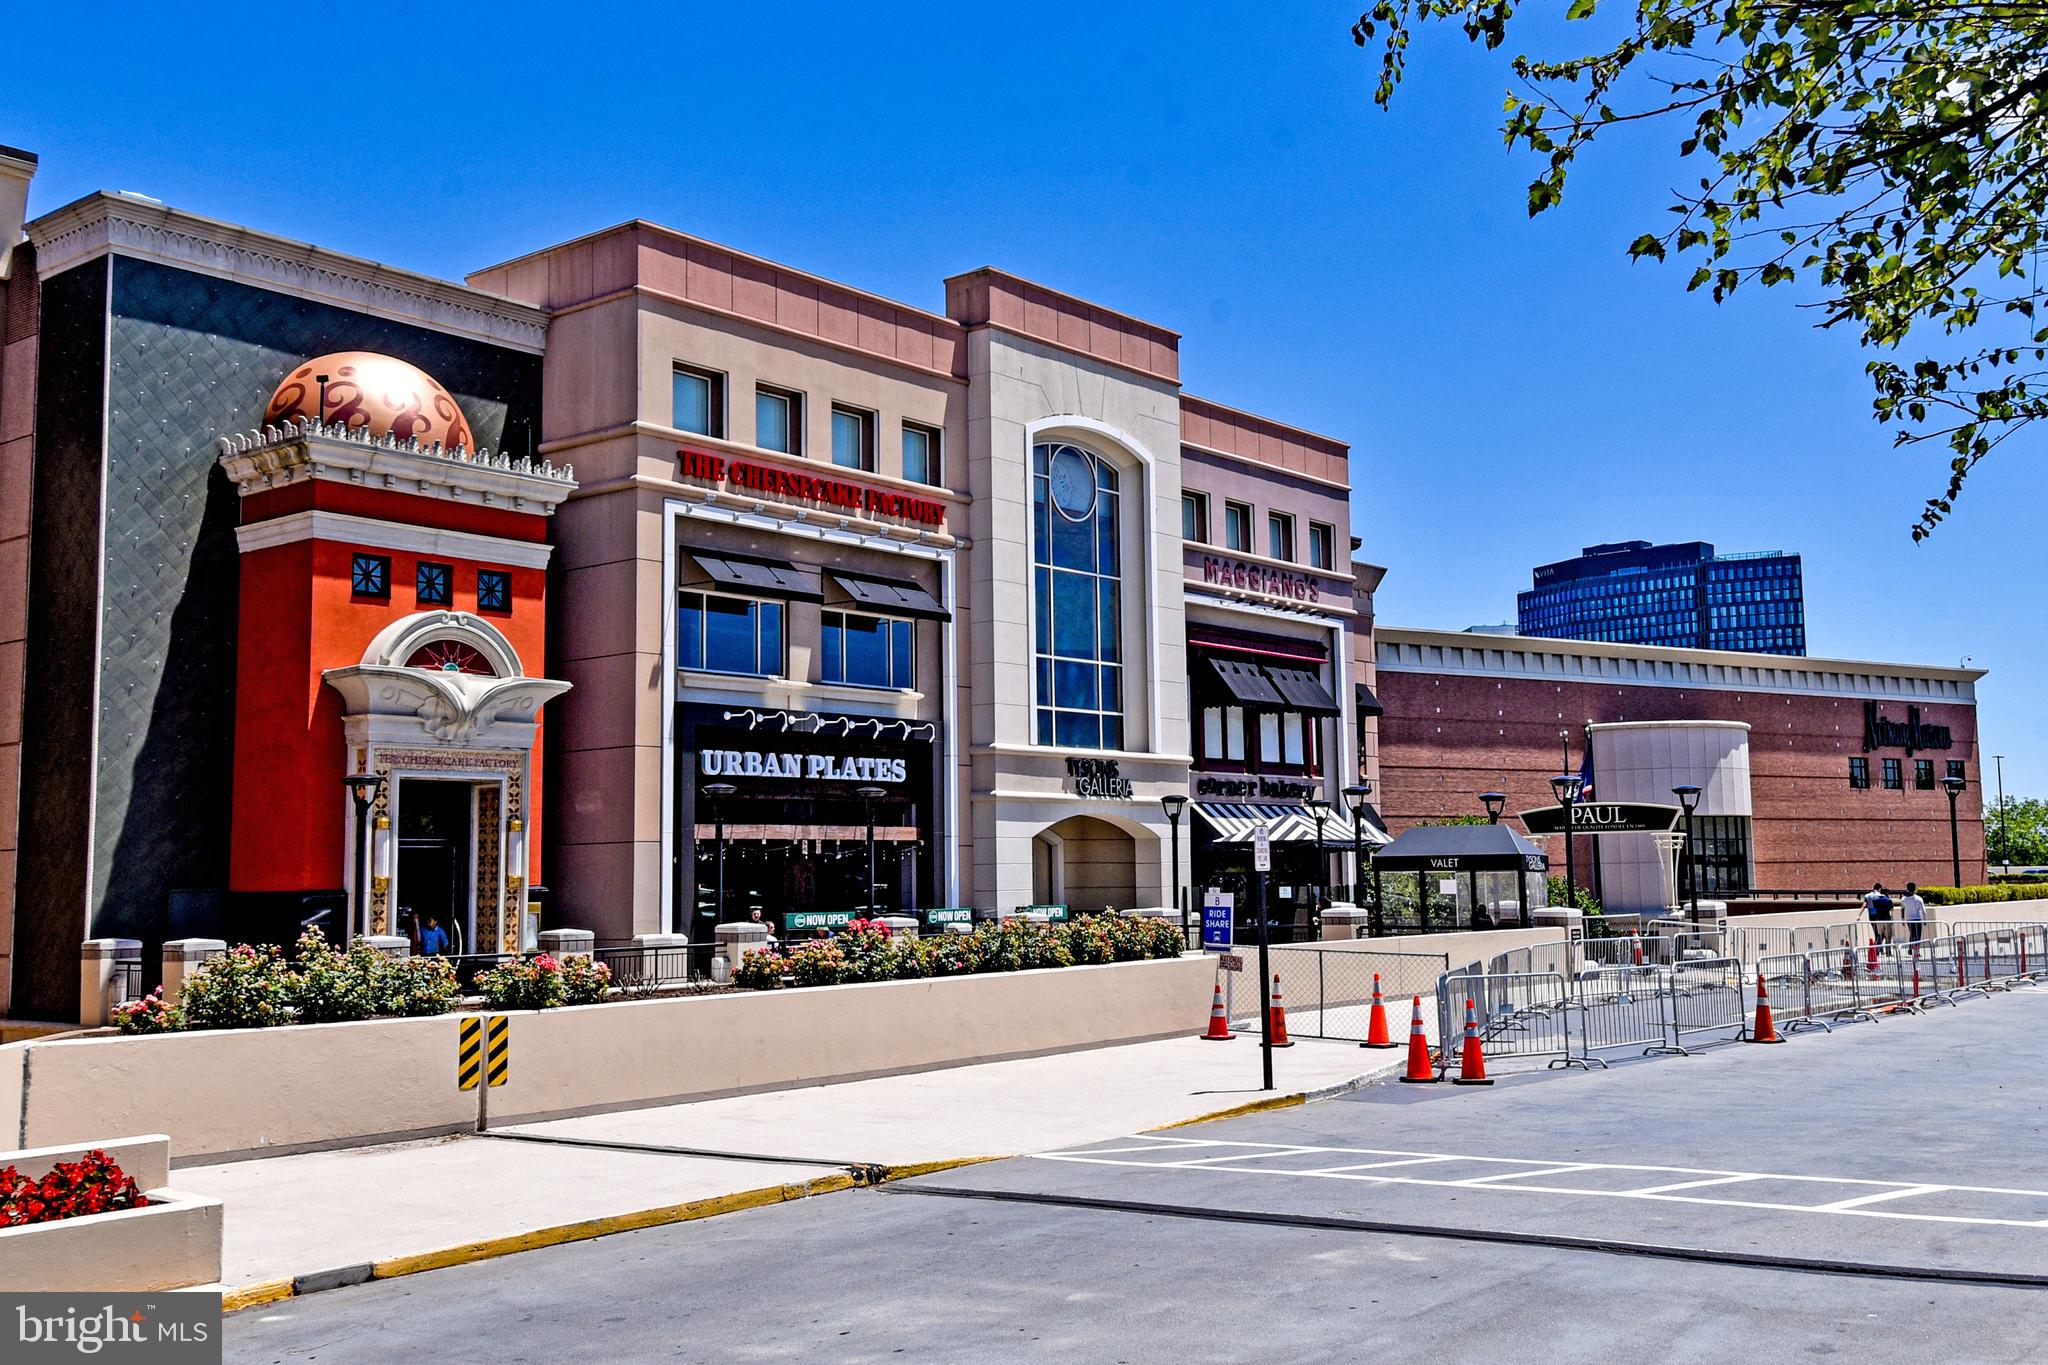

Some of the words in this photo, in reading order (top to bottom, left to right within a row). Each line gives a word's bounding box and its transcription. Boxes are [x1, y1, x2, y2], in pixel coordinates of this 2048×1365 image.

[677, 449, 725, 481] THE
[728, 460, 863, 508] CHEESECAKE
[865, 488, 947, 525] FACTORY
[1203, 556, 1320, 603] MAGGIANO'S
[474, 758, 519, 769] FACTORY
[700, 750, 803, 778] URBAN
[806, 754, 906, 783] PLATES
[1077, 776, 1134, 796] GALLERIA
[1571, 806, 1627, 825] PAUL
[1430, 858, 1460, 868] VALET
[1215, 897, 1220, 906] B
[937, 911, 954, 922] NOW
[954, 910, 971, 921] OPEN
[1047, 907, 1064, 918] OPEN
[1208, 909, 1227, 918] RIDE
[806, 915, 827, 926] NOW
[827, 914, 849, 925] OPEN
[1205, 920, 1230, 929] SHARE
